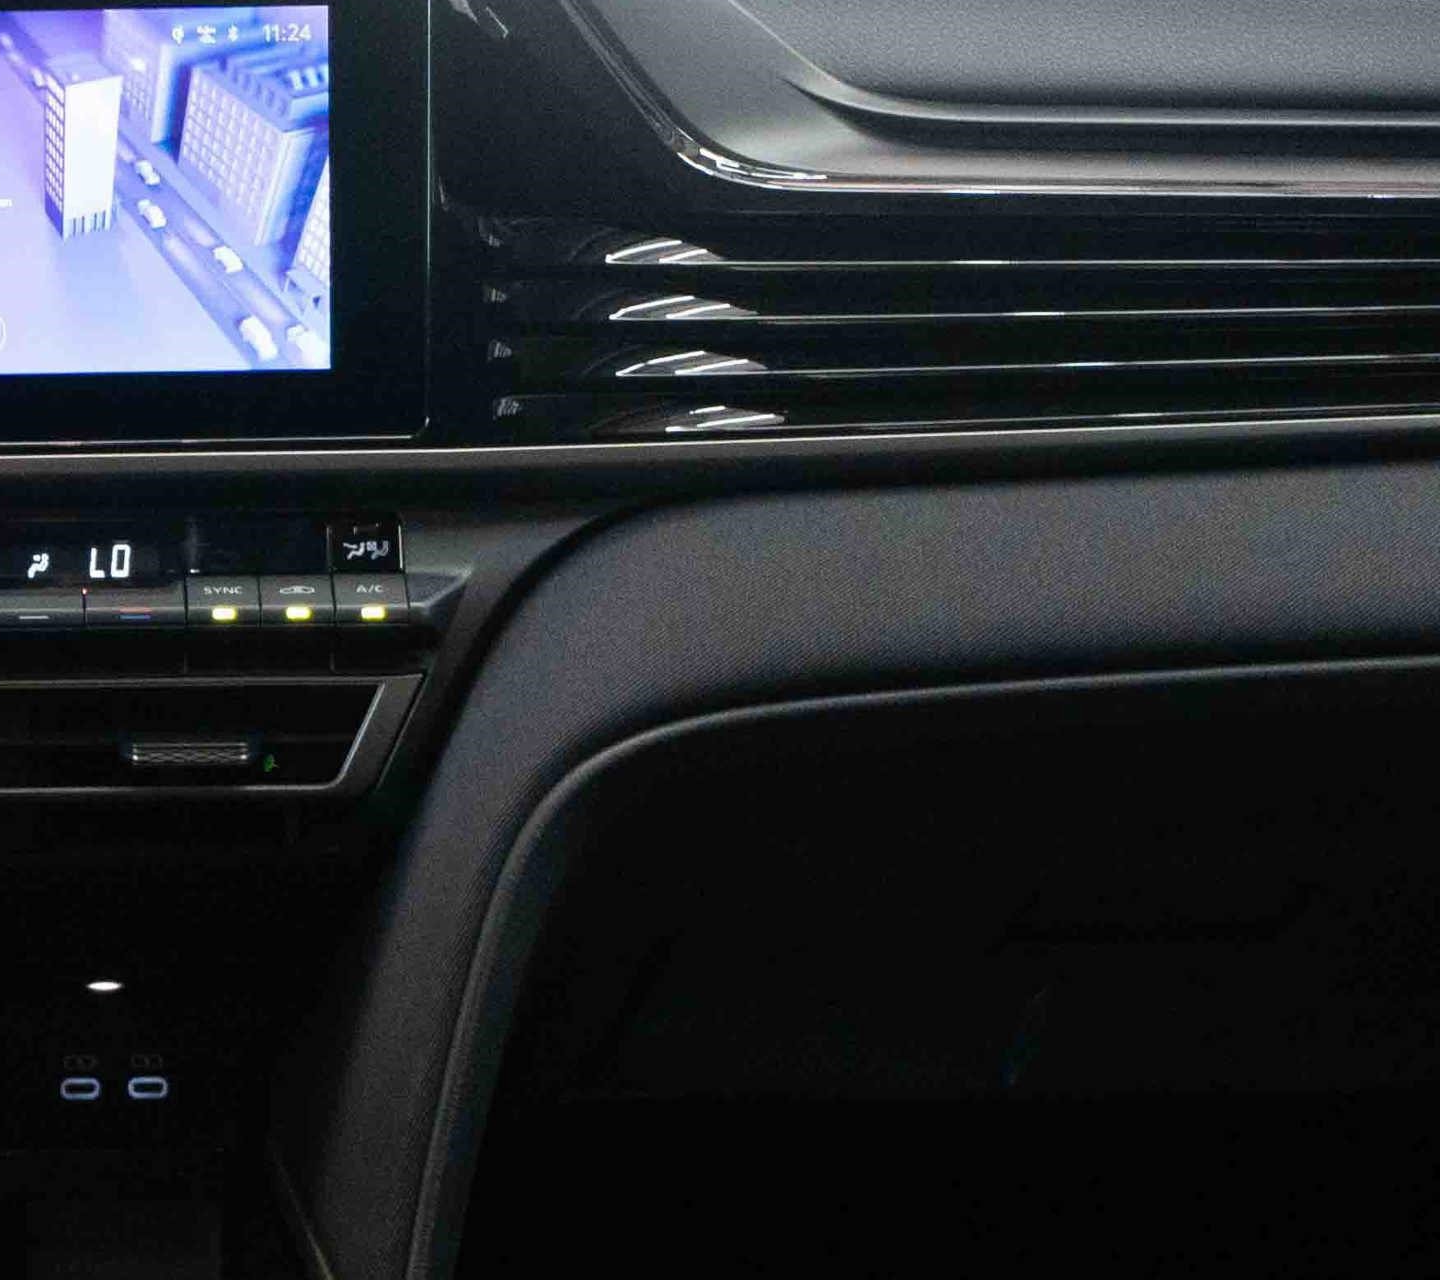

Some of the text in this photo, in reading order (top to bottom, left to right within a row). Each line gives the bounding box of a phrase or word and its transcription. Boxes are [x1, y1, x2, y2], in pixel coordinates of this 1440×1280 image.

[262, 23, 312, 43] 11:24
[89, 544, 130, 578] LO
[204, 585, 243, 595] SYNC
[356, 584, 384, 593] A/C
